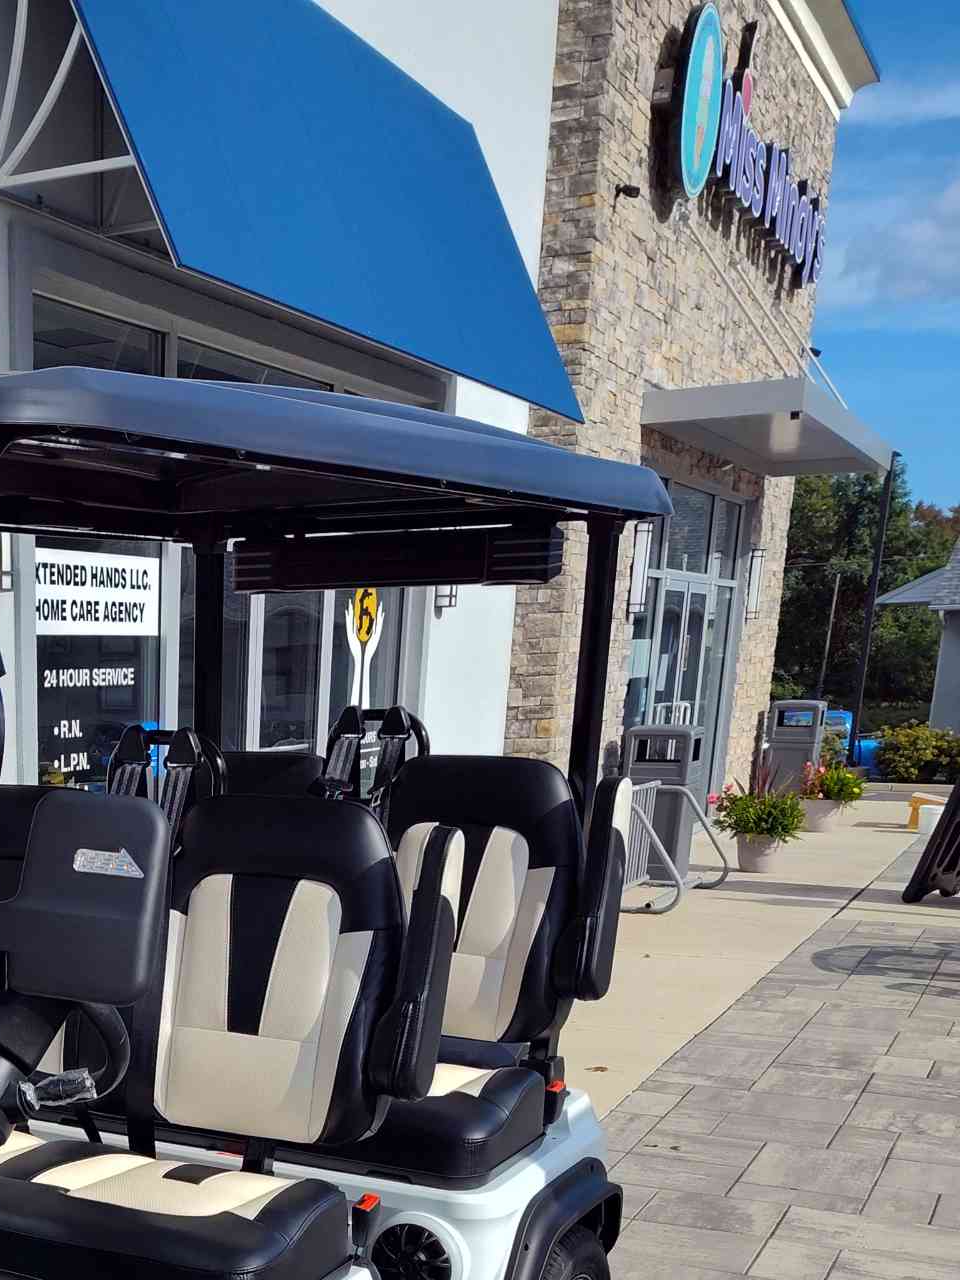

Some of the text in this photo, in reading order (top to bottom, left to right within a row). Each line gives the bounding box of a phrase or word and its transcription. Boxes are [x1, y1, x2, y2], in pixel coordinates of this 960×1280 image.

[35, 562, 151, 591] XTENDED HANDS LLC.
[70, 599, 100, 622] CARE
[102, 600, 145, 623] AGENCY
[43, 667, 135, 688] 24 HOUR SERVICE
